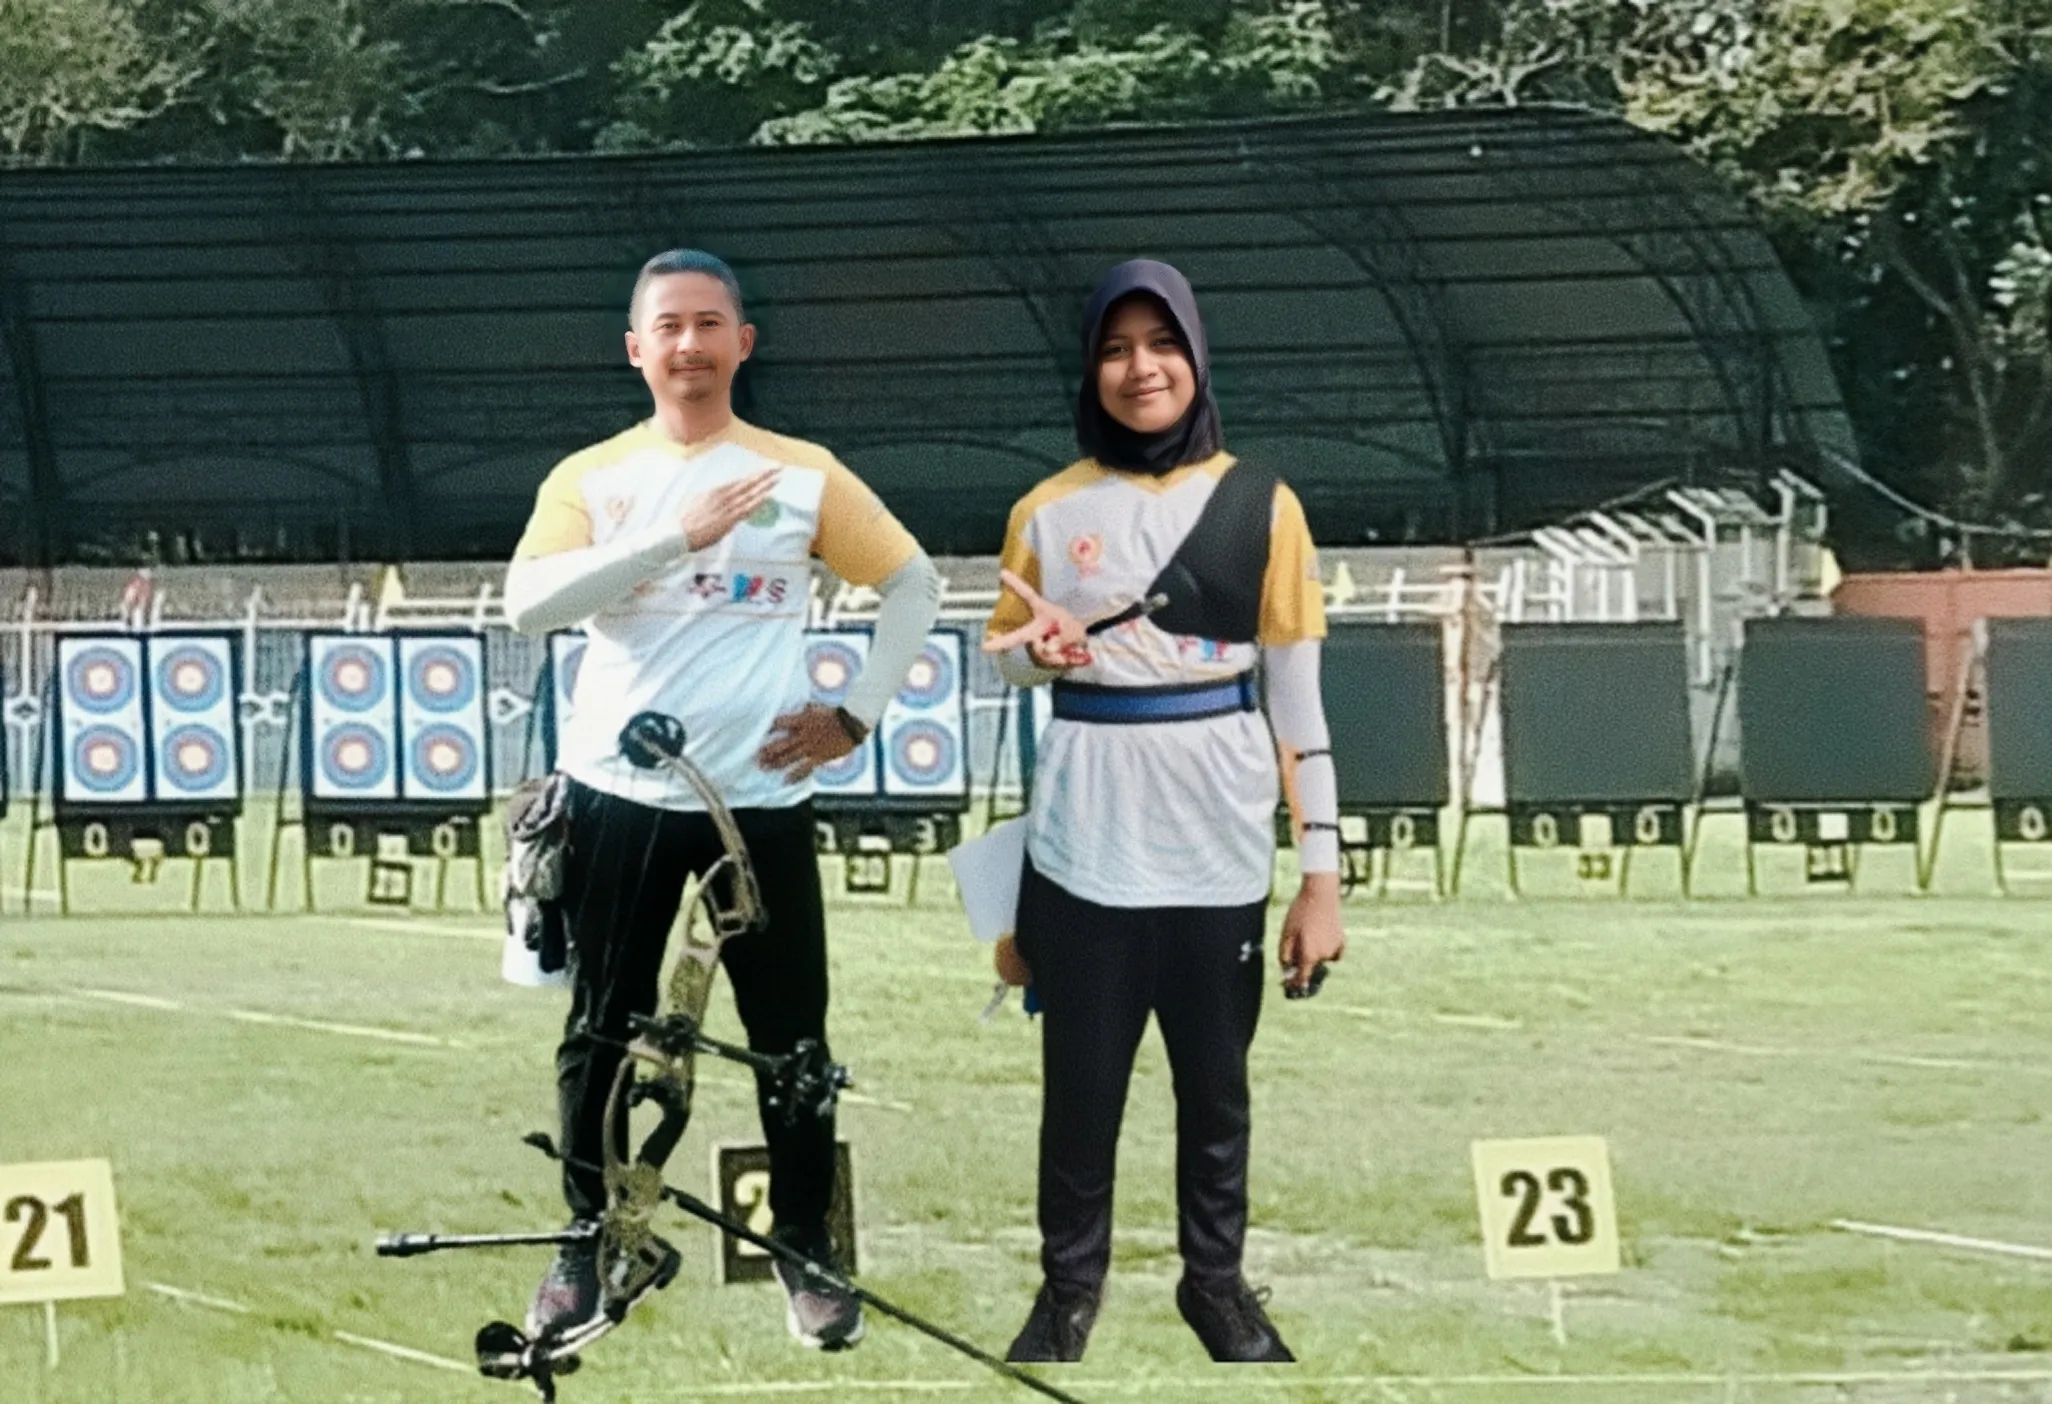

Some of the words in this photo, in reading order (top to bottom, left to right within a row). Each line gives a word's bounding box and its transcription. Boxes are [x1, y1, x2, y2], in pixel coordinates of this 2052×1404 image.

[4, 1191, 91, 1271] 21
[734, 1171, 774, 1256] 2
[1501, 1167, 1595, 1247] 23
